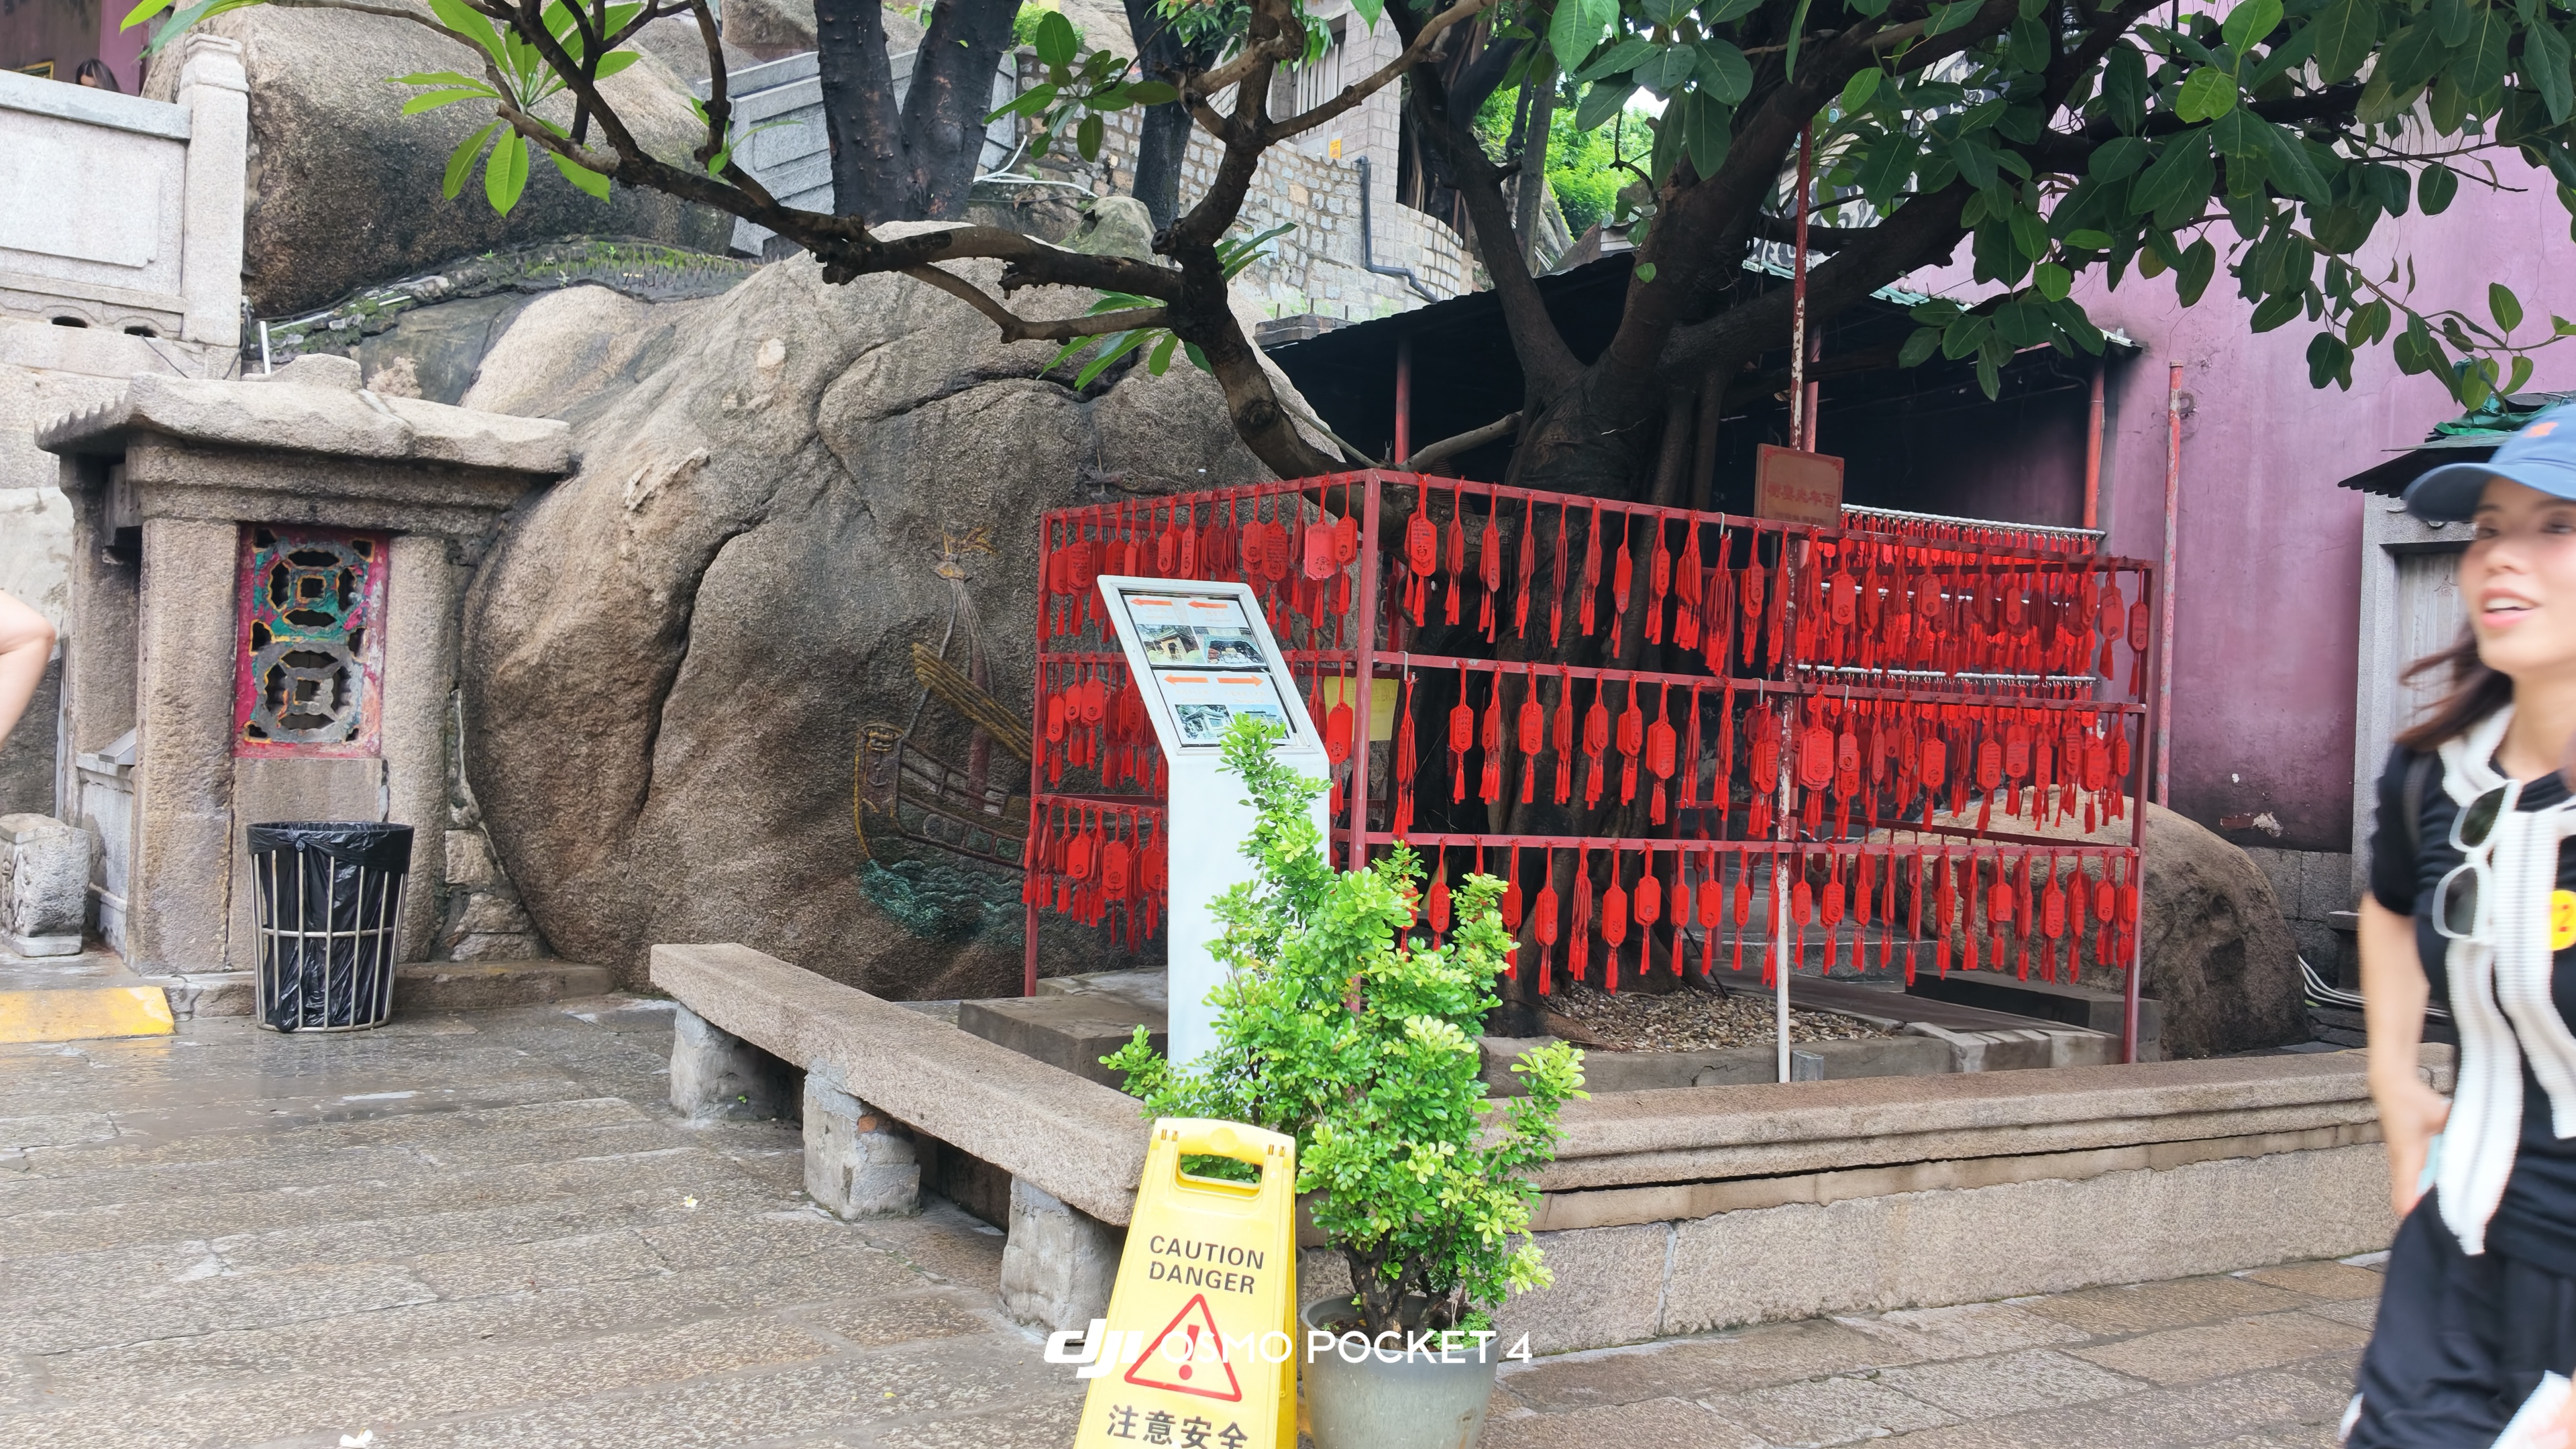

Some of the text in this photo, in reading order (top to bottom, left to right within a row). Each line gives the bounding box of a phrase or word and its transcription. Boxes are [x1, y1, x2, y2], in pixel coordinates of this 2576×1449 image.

[1150, 1235, 1264, 1269] CAUTION
[1149, 1260, 1255, 1295] DANGER
[1107, 1404, 1249, 1449] 注意安全
